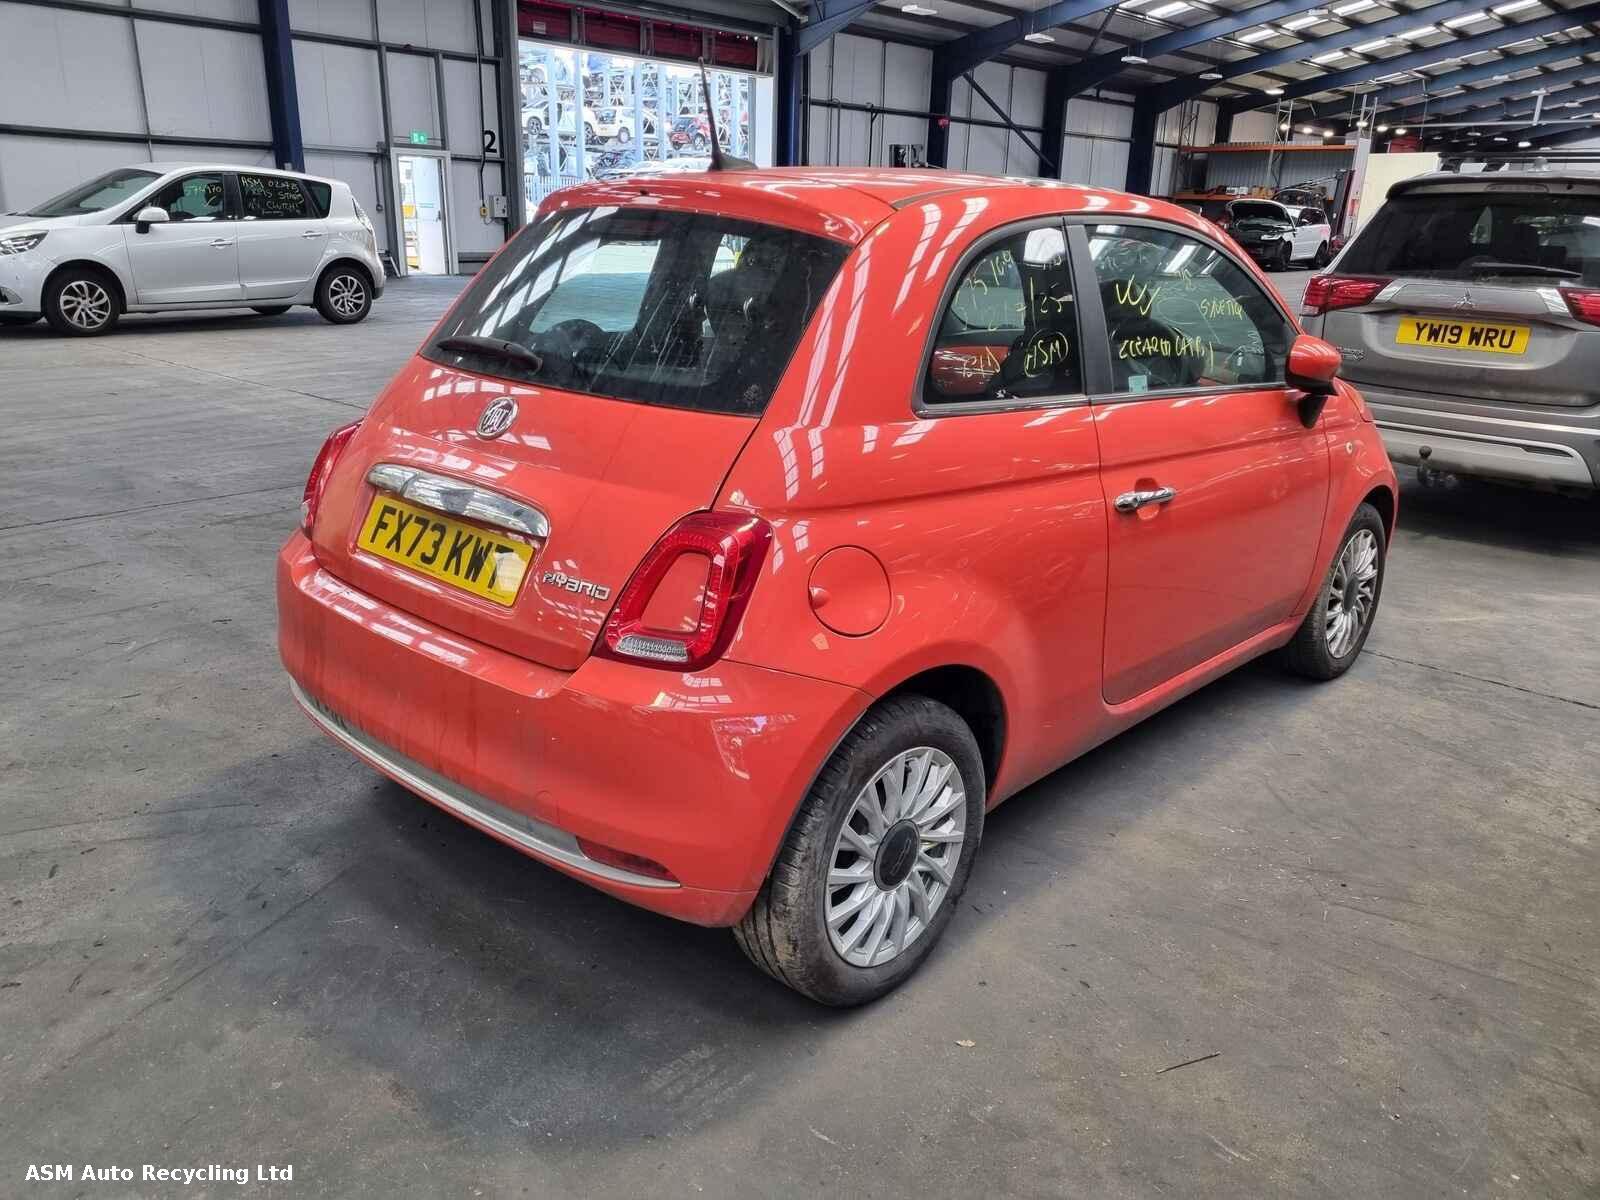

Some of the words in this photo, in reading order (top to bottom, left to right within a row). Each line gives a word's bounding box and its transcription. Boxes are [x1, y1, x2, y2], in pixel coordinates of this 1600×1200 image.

[483, 129, 498, 154] 2
[1415, 322, 1463, 344] YW19
[1467, 326, 1516, 349] WRU
[370, 504, 447, 565] FX73
[543, 572, 610, 600] HYBRID
